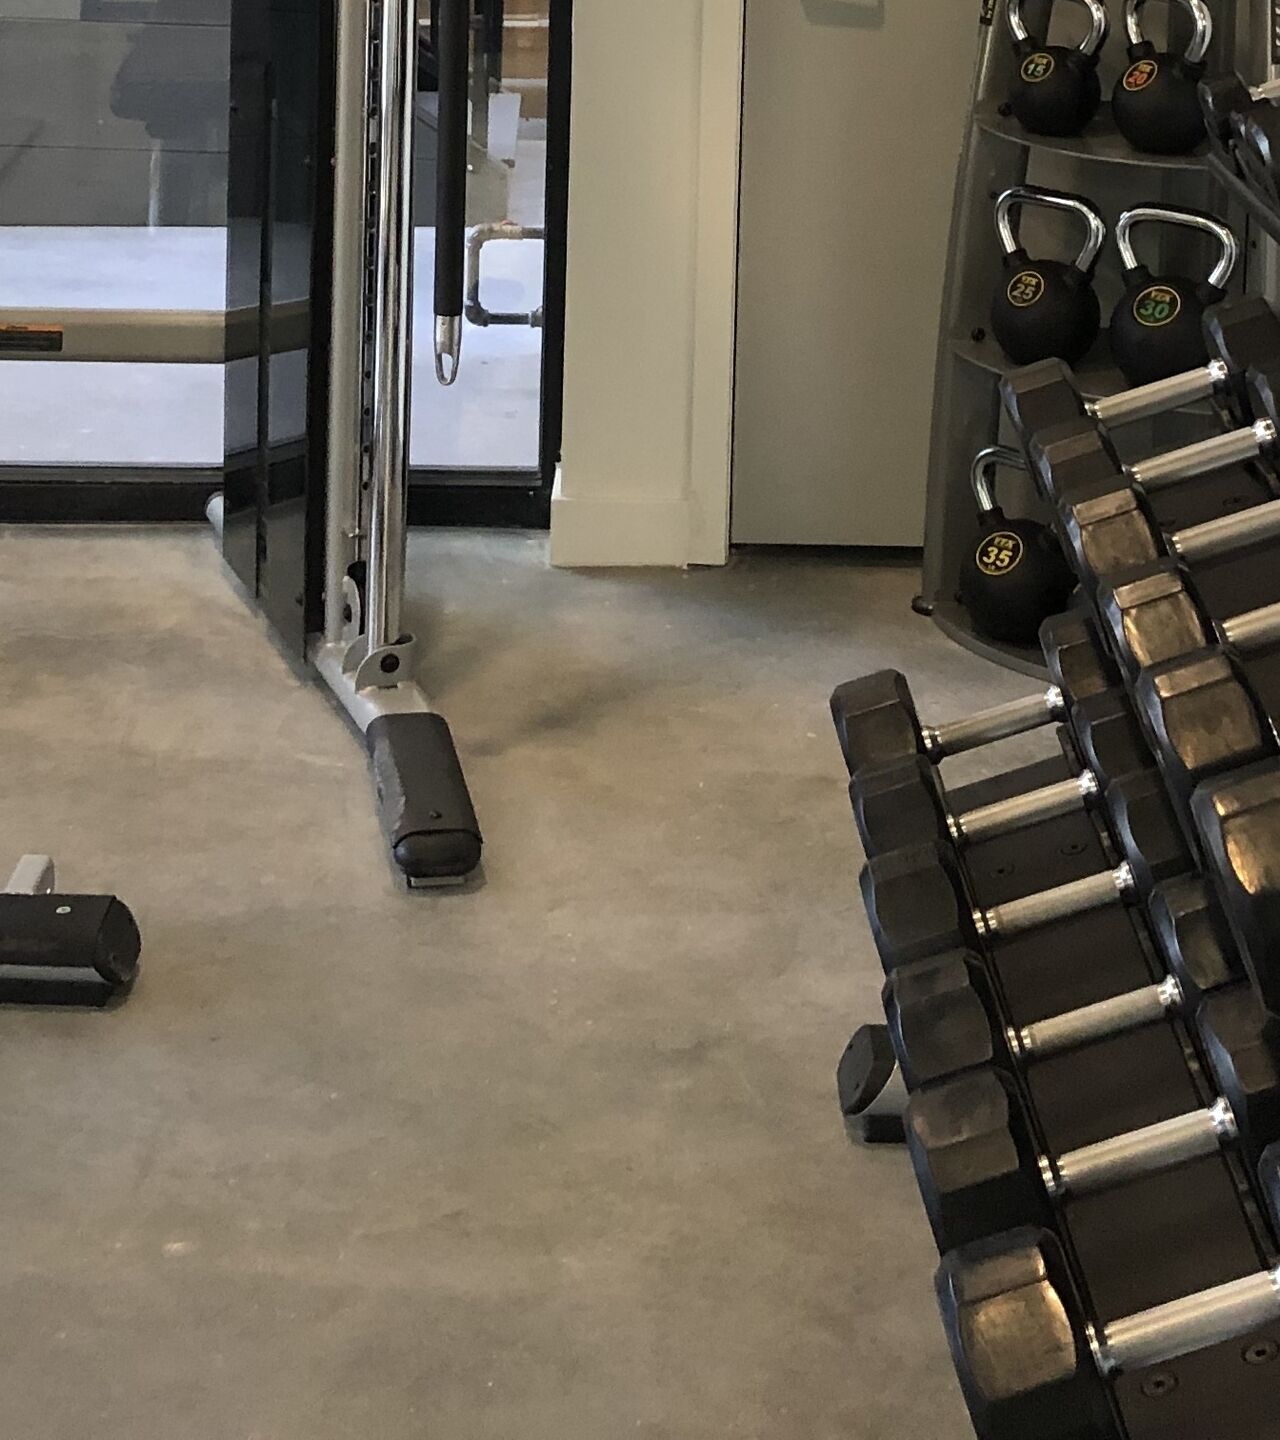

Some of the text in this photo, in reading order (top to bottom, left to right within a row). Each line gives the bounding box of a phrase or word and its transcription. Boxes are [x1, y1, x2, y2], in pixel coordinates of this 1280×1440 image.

[1027, 63, 1046, 76] 15
[1128, 71, 1148, 85] 20
[1011, 283, 1035, 300] 25
[1140, 300, 1169, 319] 30
[982, 546, 1013, 567] 35
